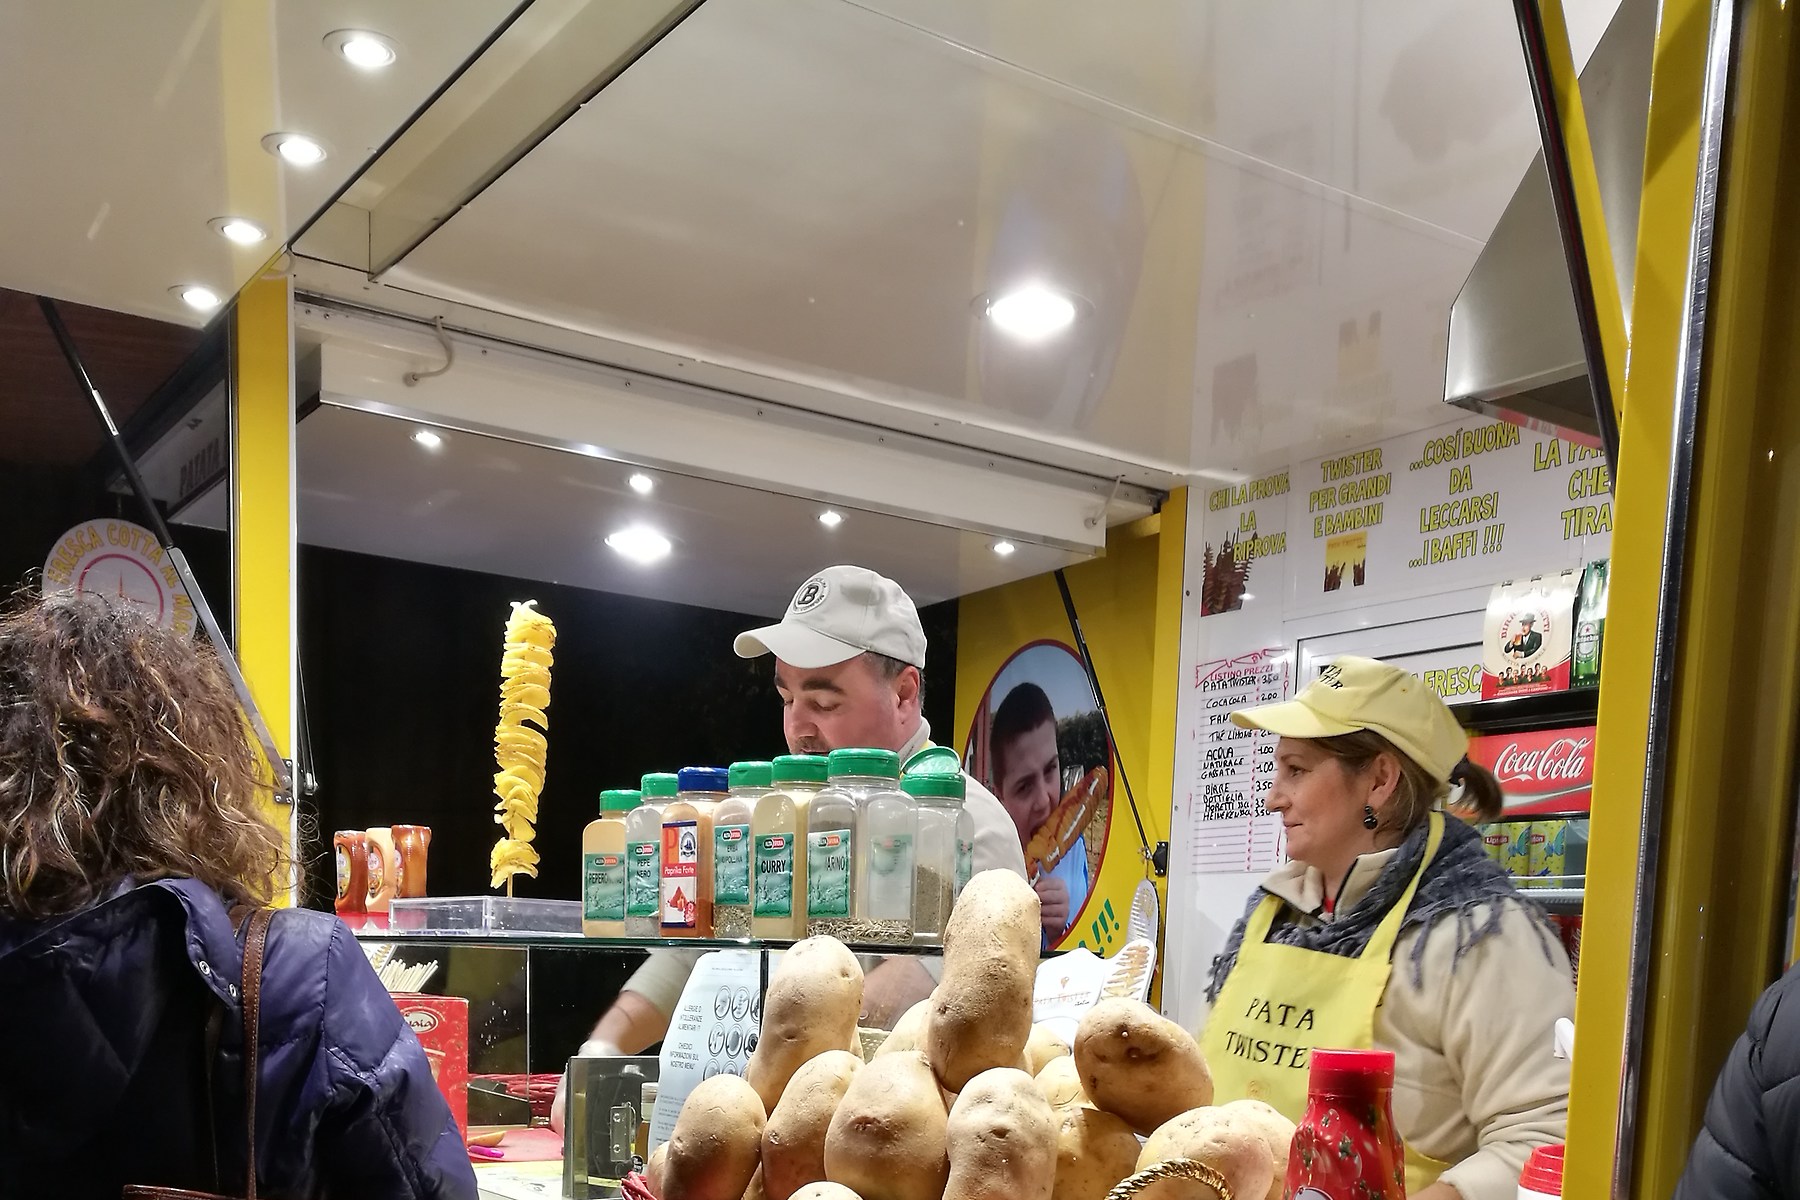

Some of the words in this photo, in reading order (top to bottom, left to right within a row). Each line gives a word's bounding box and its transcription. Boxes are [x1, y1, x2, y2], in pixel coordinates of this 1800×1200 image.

[1462, 421, 1520, 459] BUONA
[1534, 439, 1562, 472] LA
[1321, 448, 1383, 484] TWISTER
[1449, 464, 1473, 495] DA
[1568, 465, 1612, 500] CHE
[1209, 488, 1231, 512] CHI
[1231, 483, 1247, 506] LA
[1249, 471, 1291, 501] PROVA
[1309, 487, 1337, 513] PER
[1338, 473, 1392, 505] GRANDI
[1240, 510, 1257, 532] LA
[1314, 516, 1324, 538] E
[1325, 502, 1384, 536] BAMBINI
[1419, 491, 1499, 534] LECCARSI
[1560, 502, 1613, 540] TIRA
[47, 525, 104, 586] FRESCA
[107, 523, 164, 566] COTTA
[1233, 531, 1286, 562] RIPROVA
[1430, 530, 1478, 565] BAFFI
[1210, 670, 1241, 682] LISTINO
[1244, 664, 1273, 677] PREZZI
[1423, 664, 1483, 699] FRESC
[1201, 768, 1236, 780] GASSATA
[1203, 758, 1245, 770] NATURALE
[637, 859, 650, 867] PEPE
[637, 870, 651, 878] NERO
[761, 860, 786, 874] CURRY
[1246, 998, 1315, 1031] PATA
[1225, 1031, 1311, 1069] TWISTE
